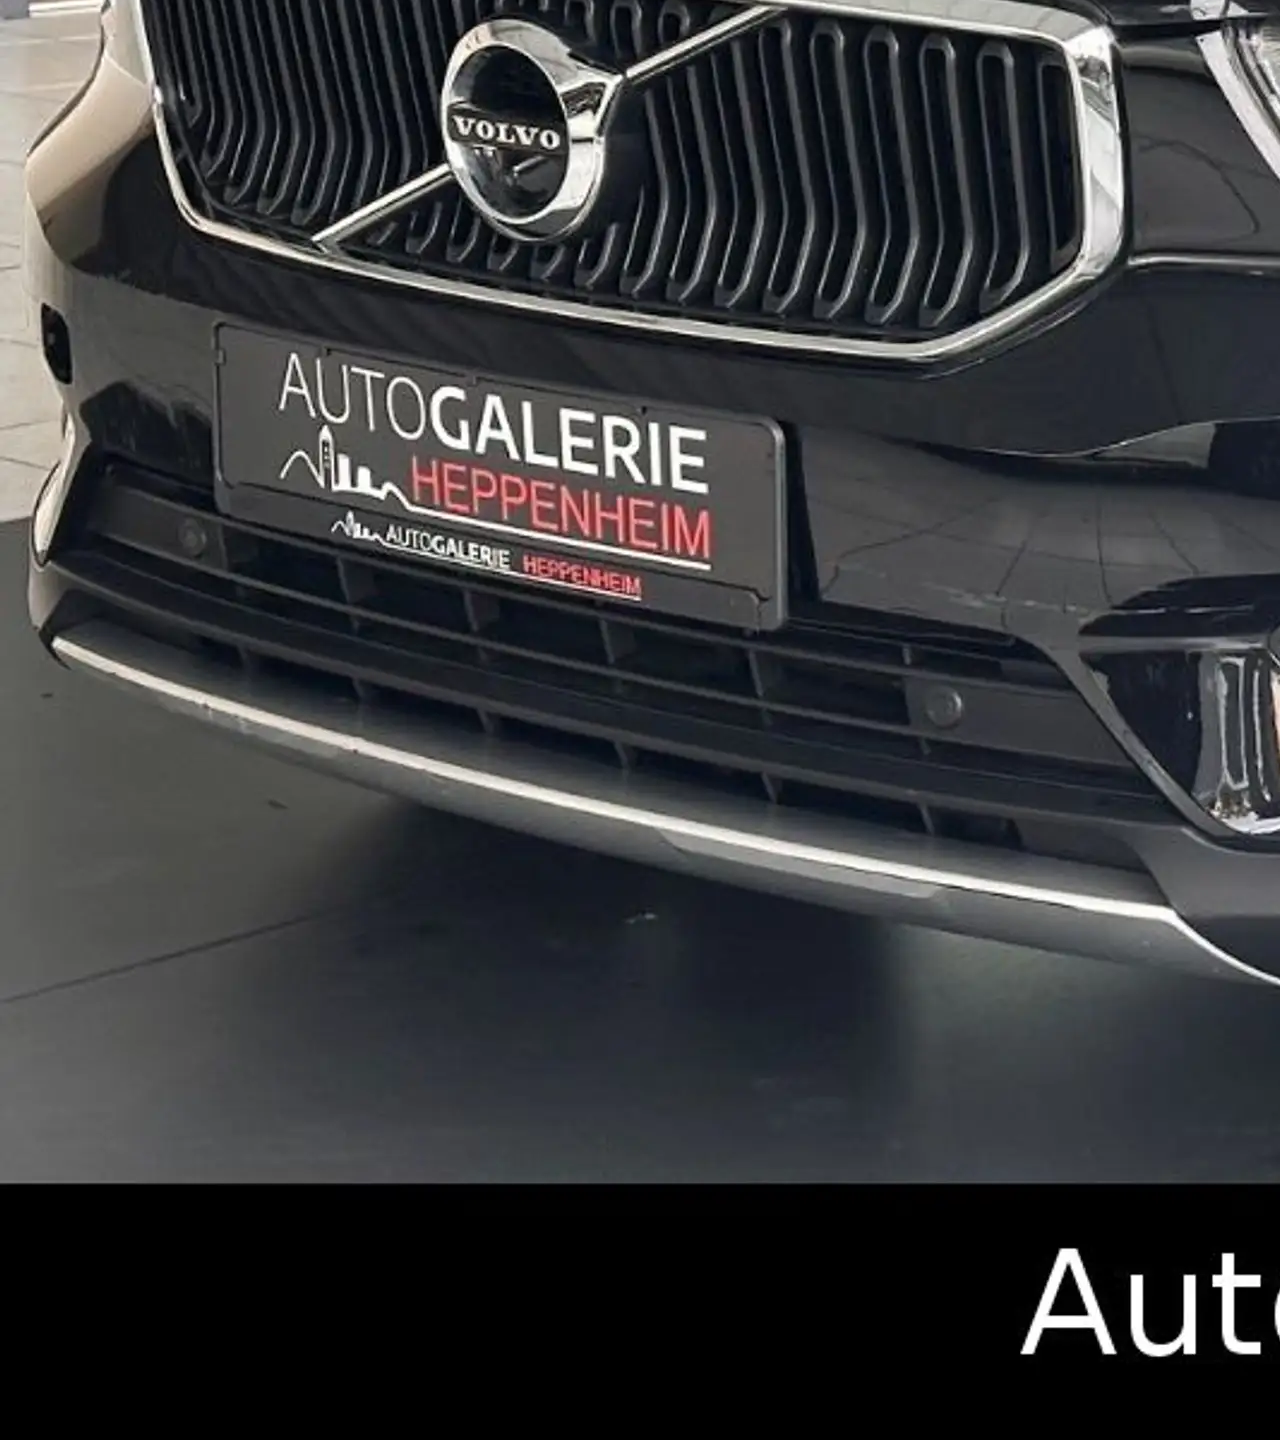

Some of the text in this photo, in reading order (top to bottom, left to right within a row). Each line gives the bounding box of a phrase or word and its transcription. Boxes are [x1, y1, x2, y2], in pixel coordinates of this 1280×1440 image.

[452, 114, 561, 150] VOLVO
[278, 352, 711, 494] AUTOGALERIE
[411, 456, 712, 559] HEPPENHEIM
[385, 523, 642, 595] AUTOGALERIE HEPPENHEIM
